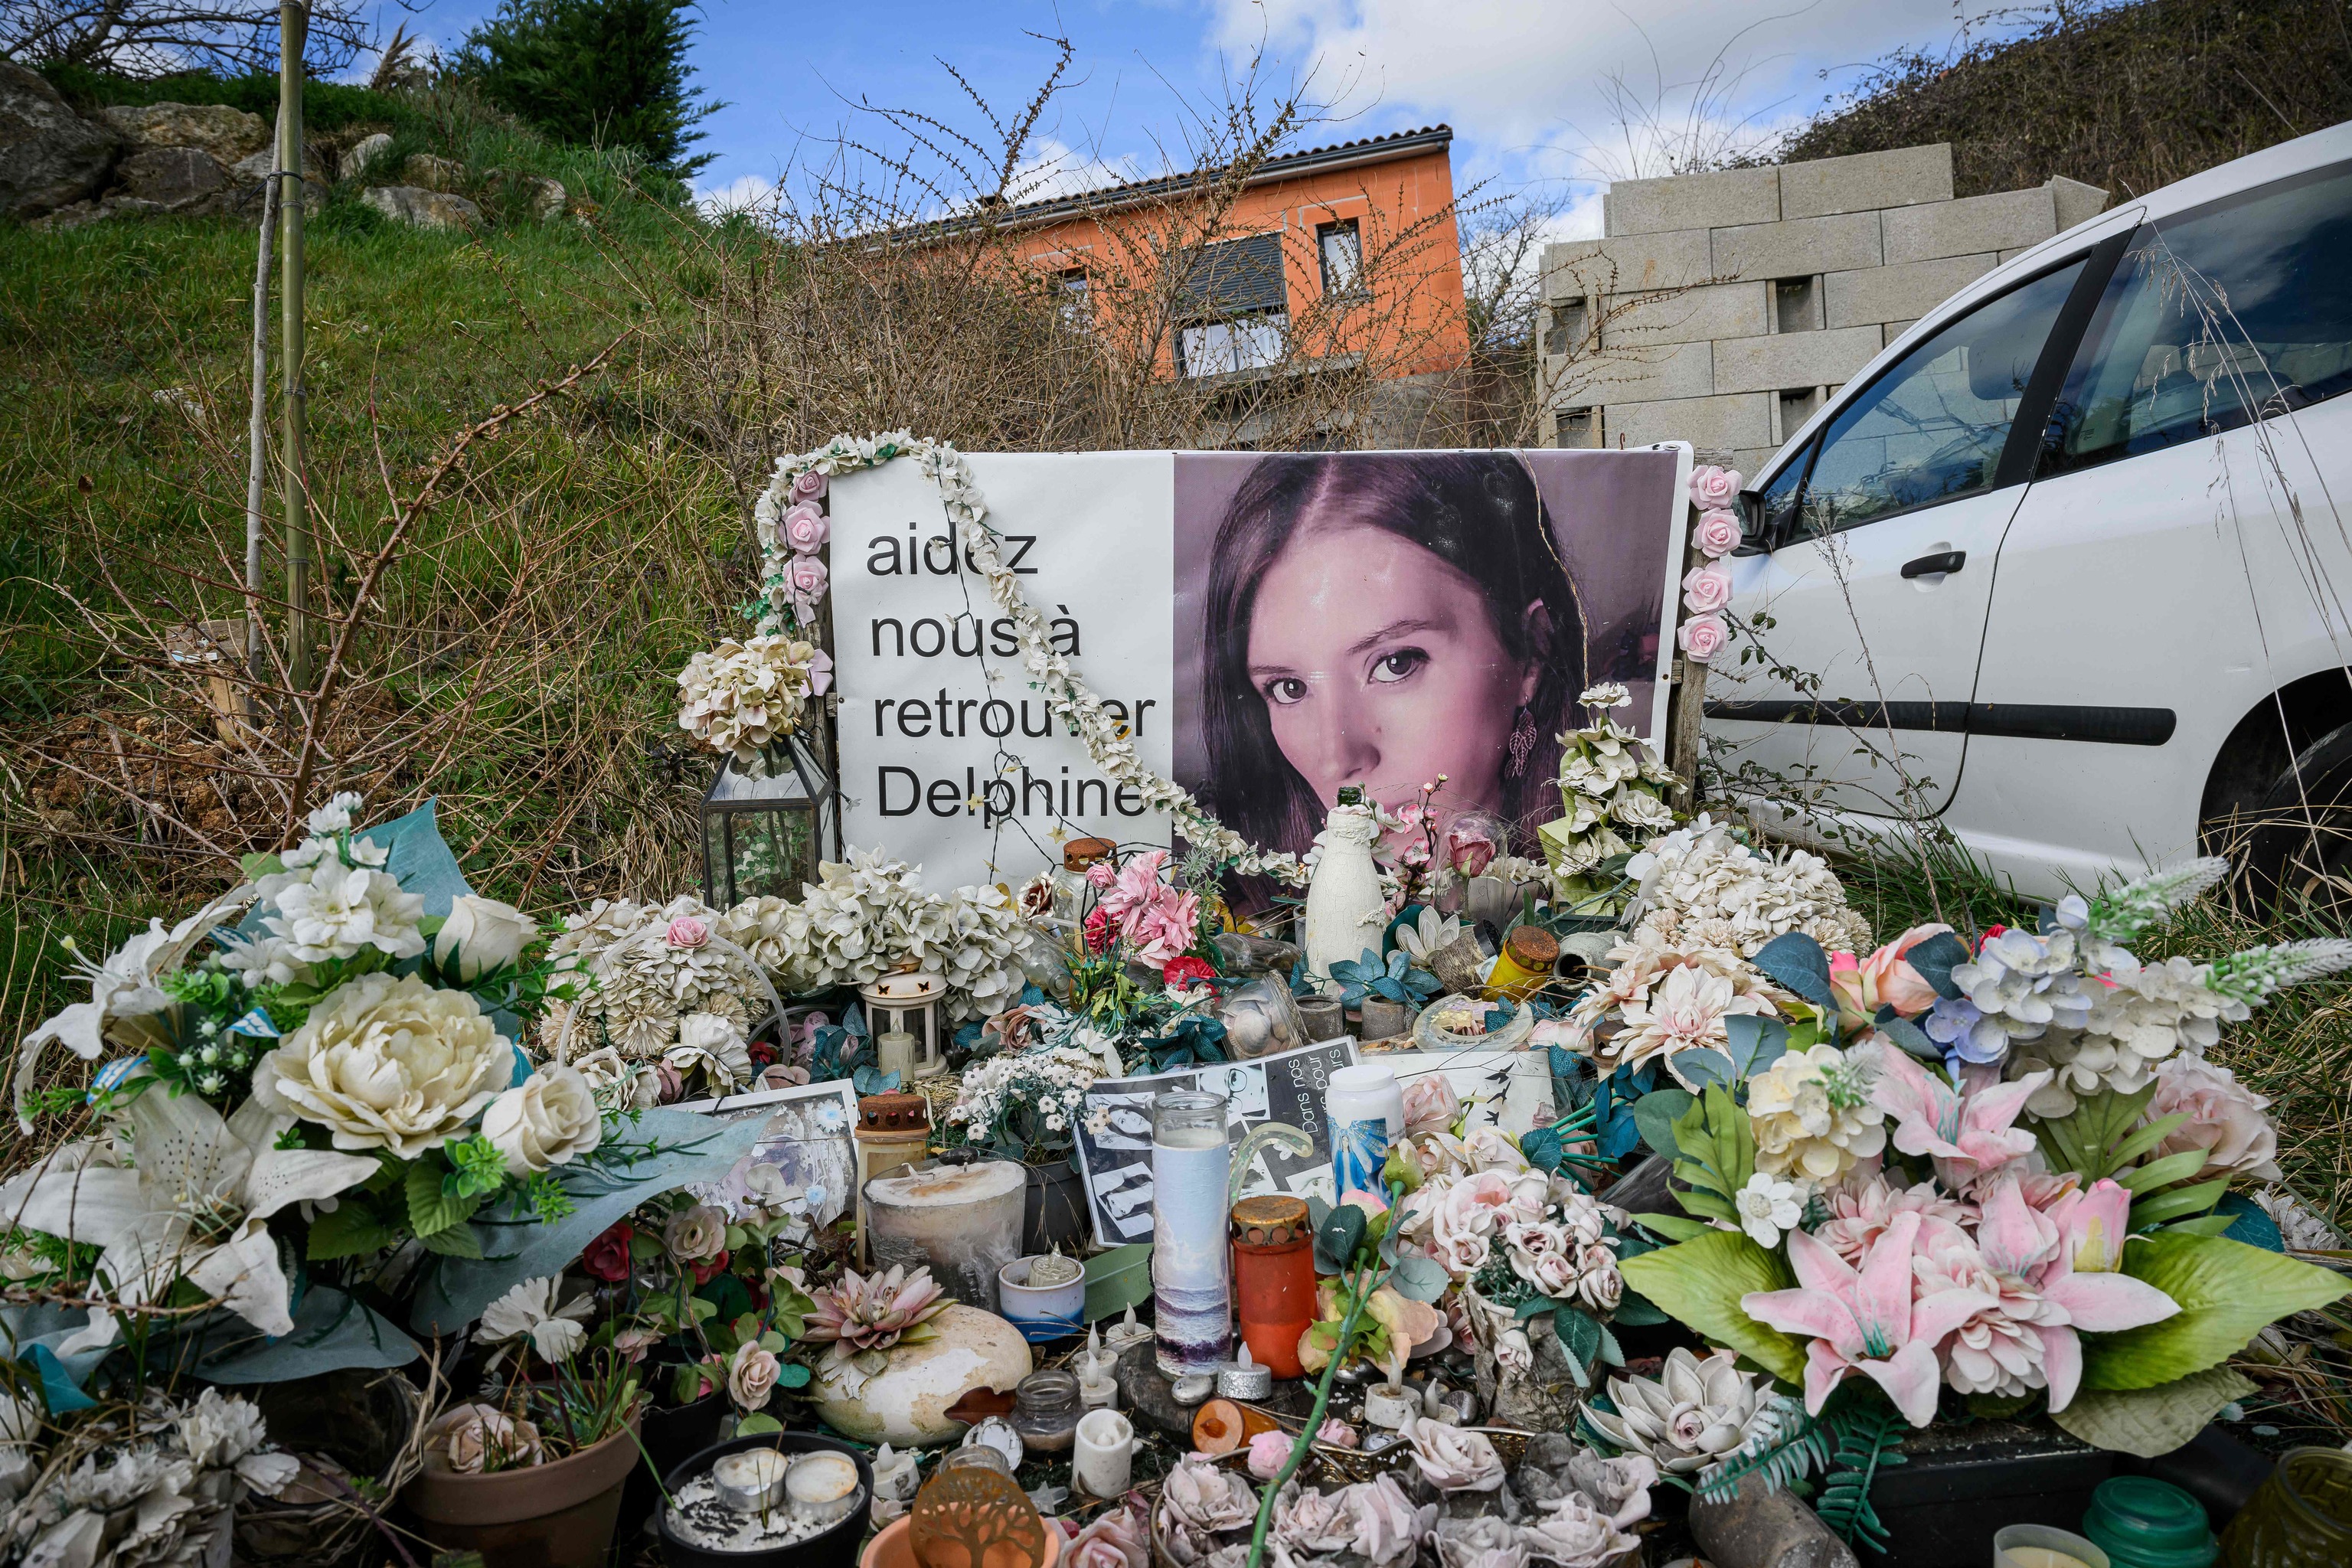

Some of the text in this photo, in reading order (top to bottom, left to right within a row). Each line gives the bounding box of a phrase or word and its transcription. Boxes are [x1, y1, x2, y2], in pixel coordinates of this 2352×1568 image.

[866, 521, 1038, 575] aidez
[871, 604, 1081, 658] nous à
[875, 688, 1157, 737] retrouer
[879, 766, 1145, 829] Delphine
[1288, 1059, 1318, 1134] Dans nos
[1308, 1055, 1328, 1090] pour
